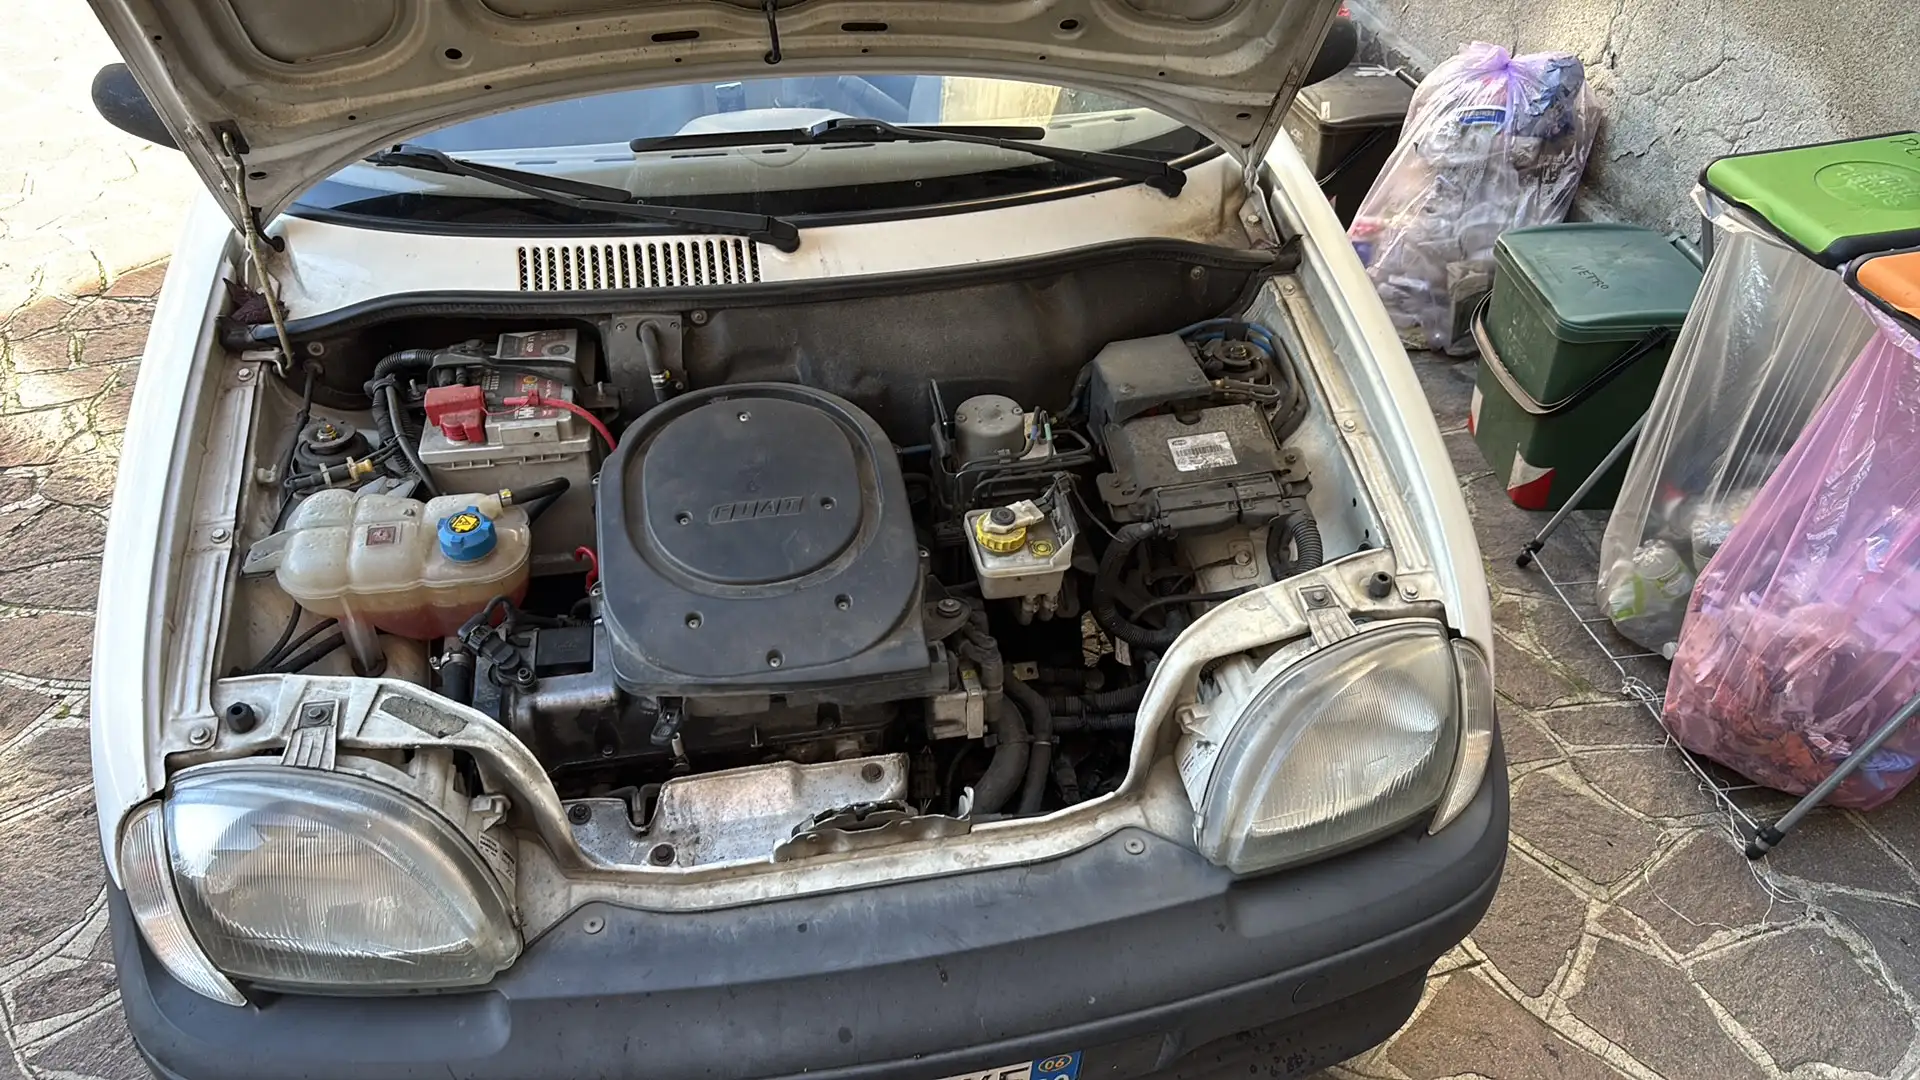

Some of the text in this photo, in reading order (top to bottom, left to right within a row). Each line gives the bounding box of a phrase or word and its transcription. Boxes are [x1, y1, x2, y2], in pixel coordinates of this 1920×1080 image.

[1571, 265, 1609, 290] VETRO
[712, 497, 798, 520] FIAT
[1044, 1057, 1065, 1071] 06
